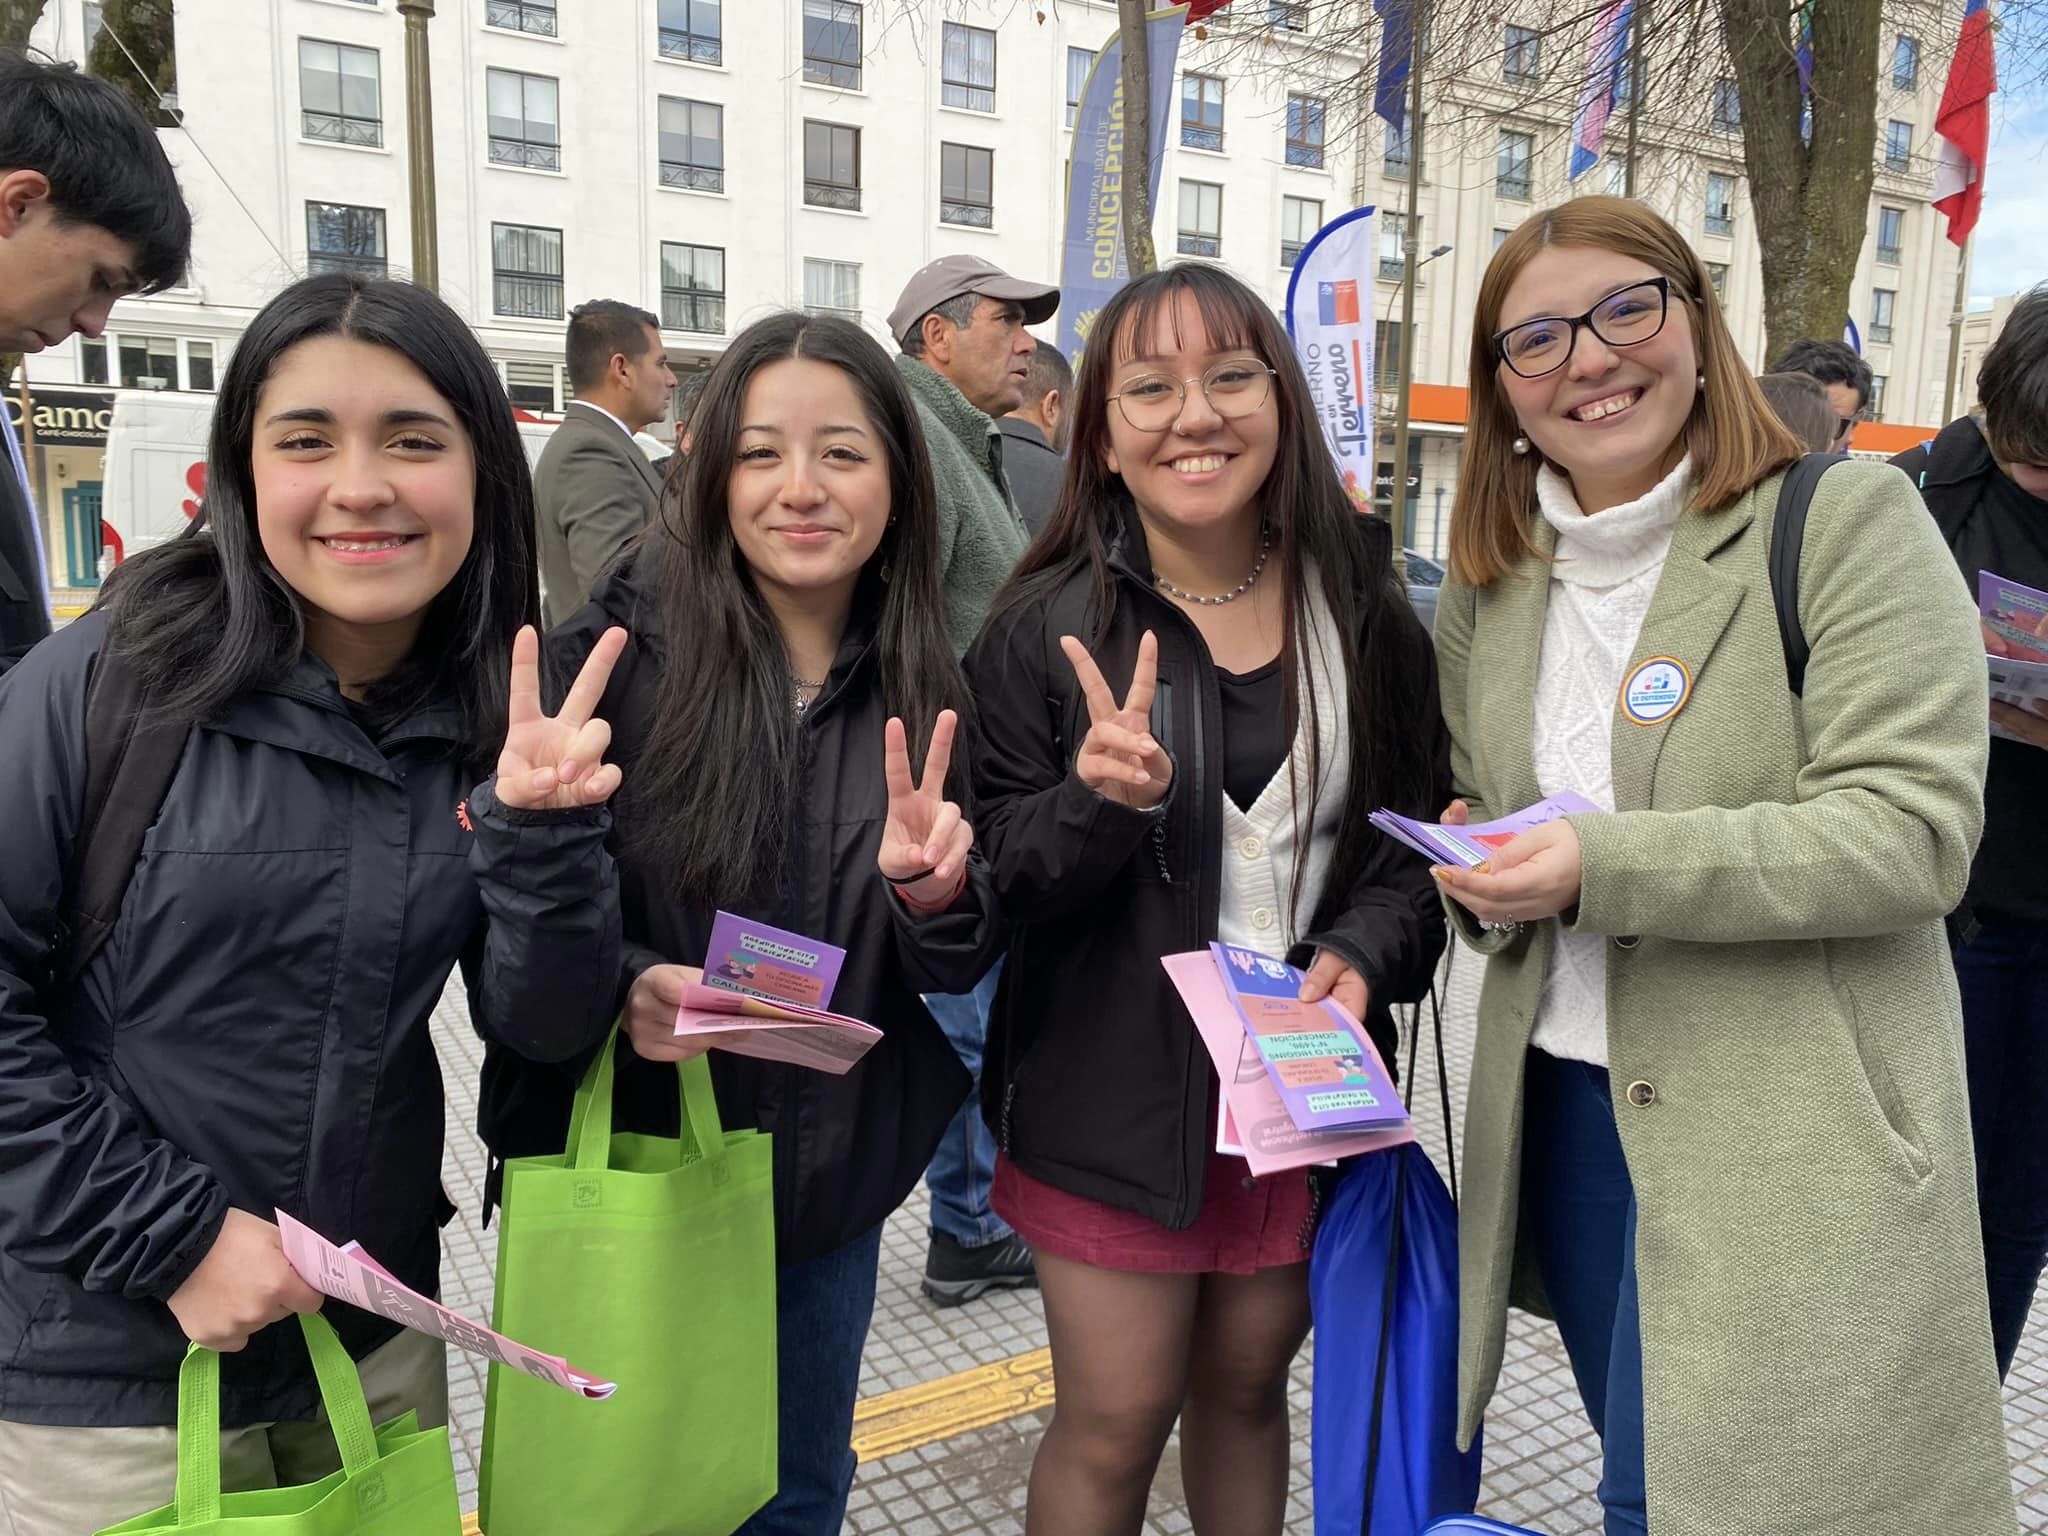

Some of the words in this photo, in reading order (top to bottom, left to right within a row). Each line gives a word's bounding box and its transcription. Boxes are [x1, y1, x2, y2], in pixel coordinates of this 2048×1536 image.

[1085, 138, 1107, 241] MUNICIPALIDAD
[1328, 343, 1367, 457] Terreno
[1327, 404, 1337, 418] en
[711, 977, 750, 994] CALLE
[1323, 1047, 1358, 1056] CALLE
